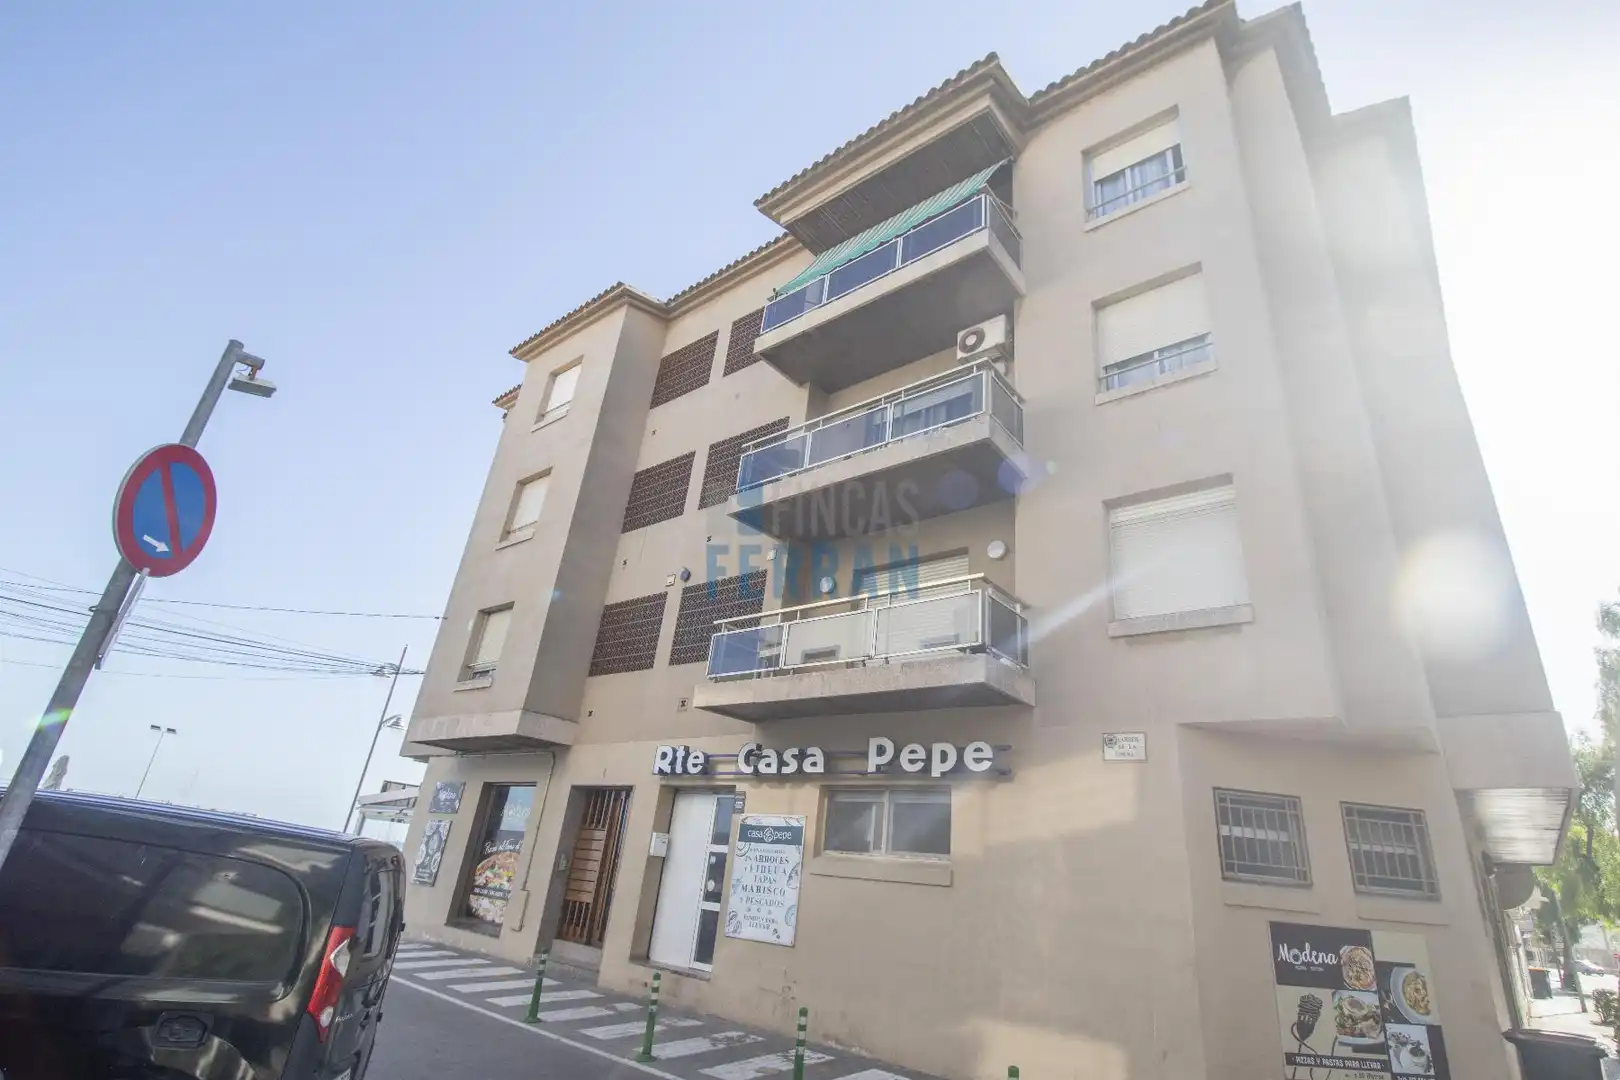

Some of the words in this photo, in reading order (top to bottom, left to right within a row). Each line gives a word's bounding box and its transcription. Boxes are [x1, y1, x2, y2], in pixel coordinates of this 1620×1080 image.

[652, 744, 706, 775] Rte
[737, 742, 825, 774] Casa
[867, 736, 994, 778] Pepe
[747, 829, 764, 839] casa
[773, 831, 793, 841] pepe
[754, 854, 790, 865] ARROCES
[754, 874, 777, 885] TAPAS
[740, 883, 787, 897] MARISCO
[745, 896, 785, 908] PESCADOS
[1278, 941, 1339, 965] Modena
[1296, 1055, 1315, 1065] PIZZAS
[1322, 1058, 1344, 1068] PASTAS
[1344, 1060, 1360, 1069] PARA
[1361, 1060, 1382, 1070] LLEVAR
